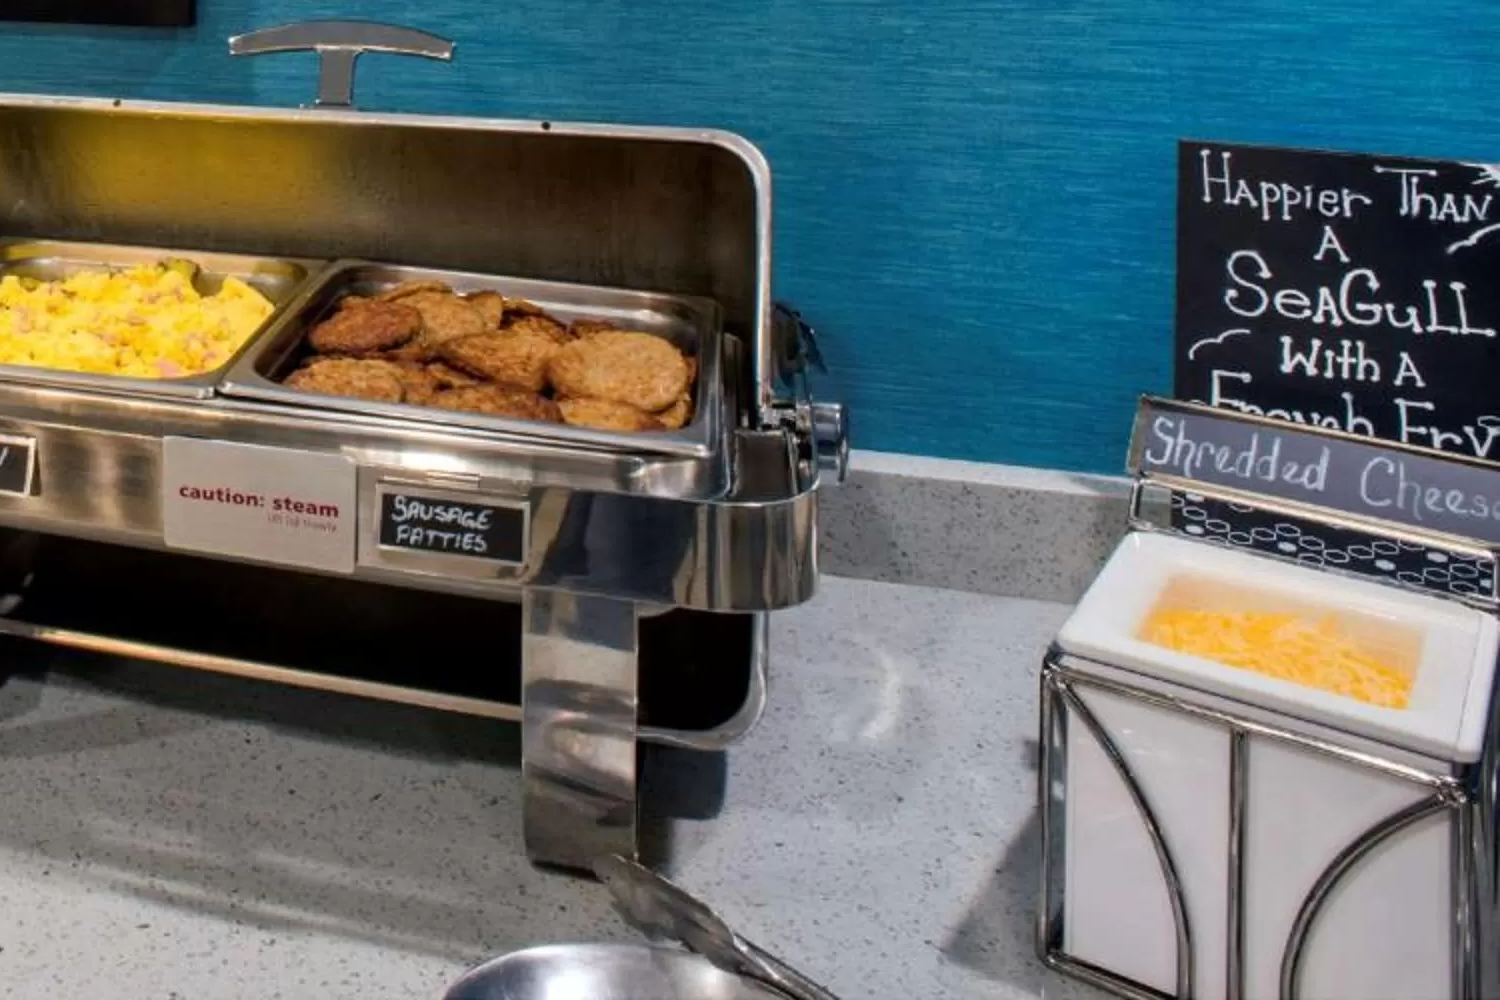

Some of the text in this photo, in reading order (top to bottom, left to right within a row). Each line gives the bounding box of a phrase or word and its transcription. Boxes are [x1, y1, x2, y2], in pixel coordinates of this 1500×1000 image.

[1313, 225, 1350, 263] A
[1394, 351, 1427, 388] A
[1145, 416, 1330, 492] Shredded
[179, 485, 340, 519] caution: steam
[396, 523, 488, 553] PATTIES
